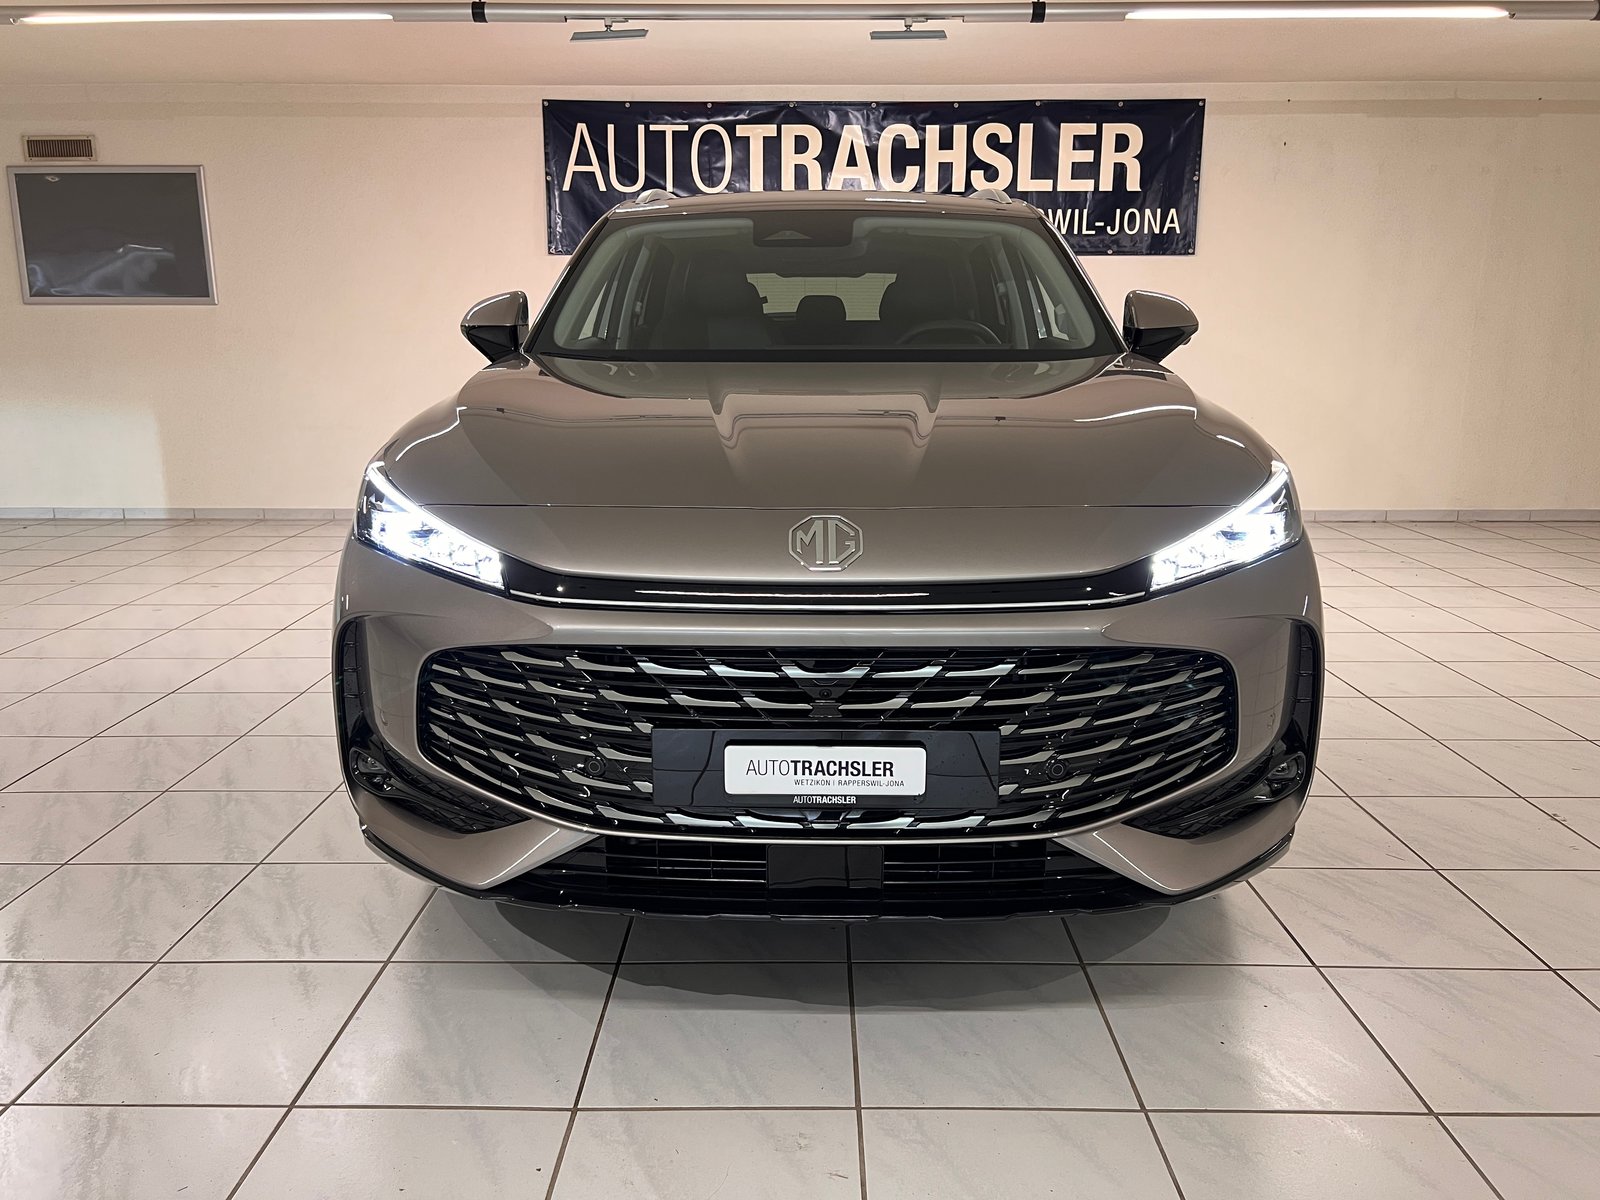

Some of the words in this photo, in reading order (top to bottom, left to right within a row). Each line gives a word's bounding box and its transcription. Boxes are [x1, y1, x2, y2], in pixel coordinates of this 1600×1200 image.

[562, 122, 1142, 193] AUTOTRACHSLER
[1037, 208, 1181, 235] WIL-JONA
[796, 519, 856, 565] MG
[745, 759, 894, 777] AUTOTRACHSLER
[837, 779, 905, 787] RAPPERSWIL-JONA
[793, 795, 857, 804] AUTOTRACHSLER
